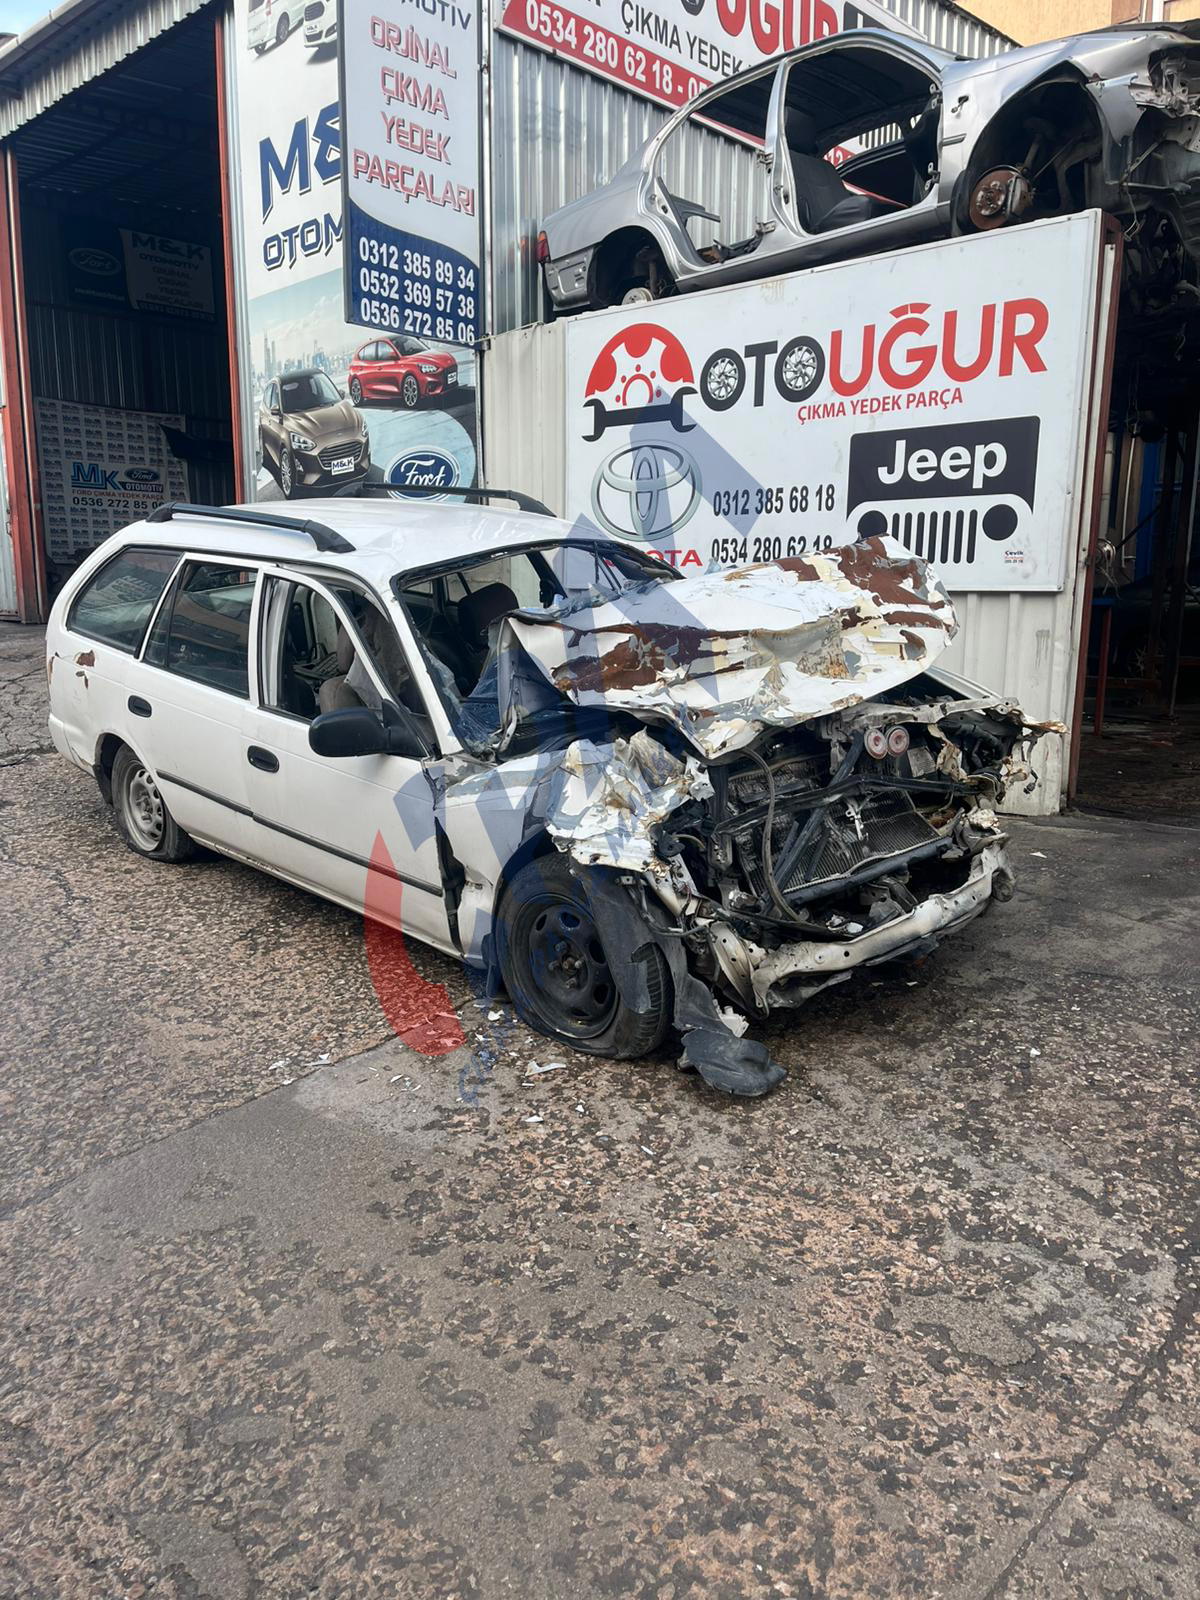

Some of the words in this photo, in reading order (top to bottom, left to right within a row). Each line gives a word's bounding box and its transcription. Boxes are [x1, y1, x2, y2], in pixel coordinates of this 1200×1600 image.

[370, 15, 457, 80] ORJİNAL
[525, 0, 577, 49] 0534
[583, 26, 618, 69] 280
[624, 46, 647, 83] 62
[652, 59, 673, 95] 18
[621, 0, 682, 54] ÇIKMA
[686, 31, 743, 78] YEDEK
[380, 65, 449, 120] ÇIKMA
[380, 111, 452, 166] YEDEK
[353, 148, 475, 216] PARÇALARI
[359, 236, 399, 270] 0312
[403, 249, 431, 279] 385
[435, 259, 453, 285] 89
[457, 265, 475, 291] 34
[360, 267, 400, 300] 0532
[403, 279, 431, 308] 369
[436, 288, 453, 313] 57
[457, 294, 475, 319] 38
[361, 298, 400, 328] 0536
[404, 308, 432, 336] 272
[436, 316, 454, 341] 85
[457, 321, 475, 346] 06
[798, 401, 847, 426] ÇIKMA
[850, 395, 903, 418] YEDEK
[906, 387, 964, 411] PARÇA
[333, 458, 353, 470] M&K
[877, 439, 1008, 489] Jeep
[72, 496, 104, 506] 0536
[107, 498, 130, 508] 272
[133, 500, 148, 509] 85
[713, 489, 750, 517] 0312
[755, 486, 784, 514] 385
[788, 485, 809, 513] 68
[815, 483, 836, 511] 18
[711, 537, 748, 564] 0534
[752, 535, 782, 563] 280
[786, 535, 808, 558] 62
